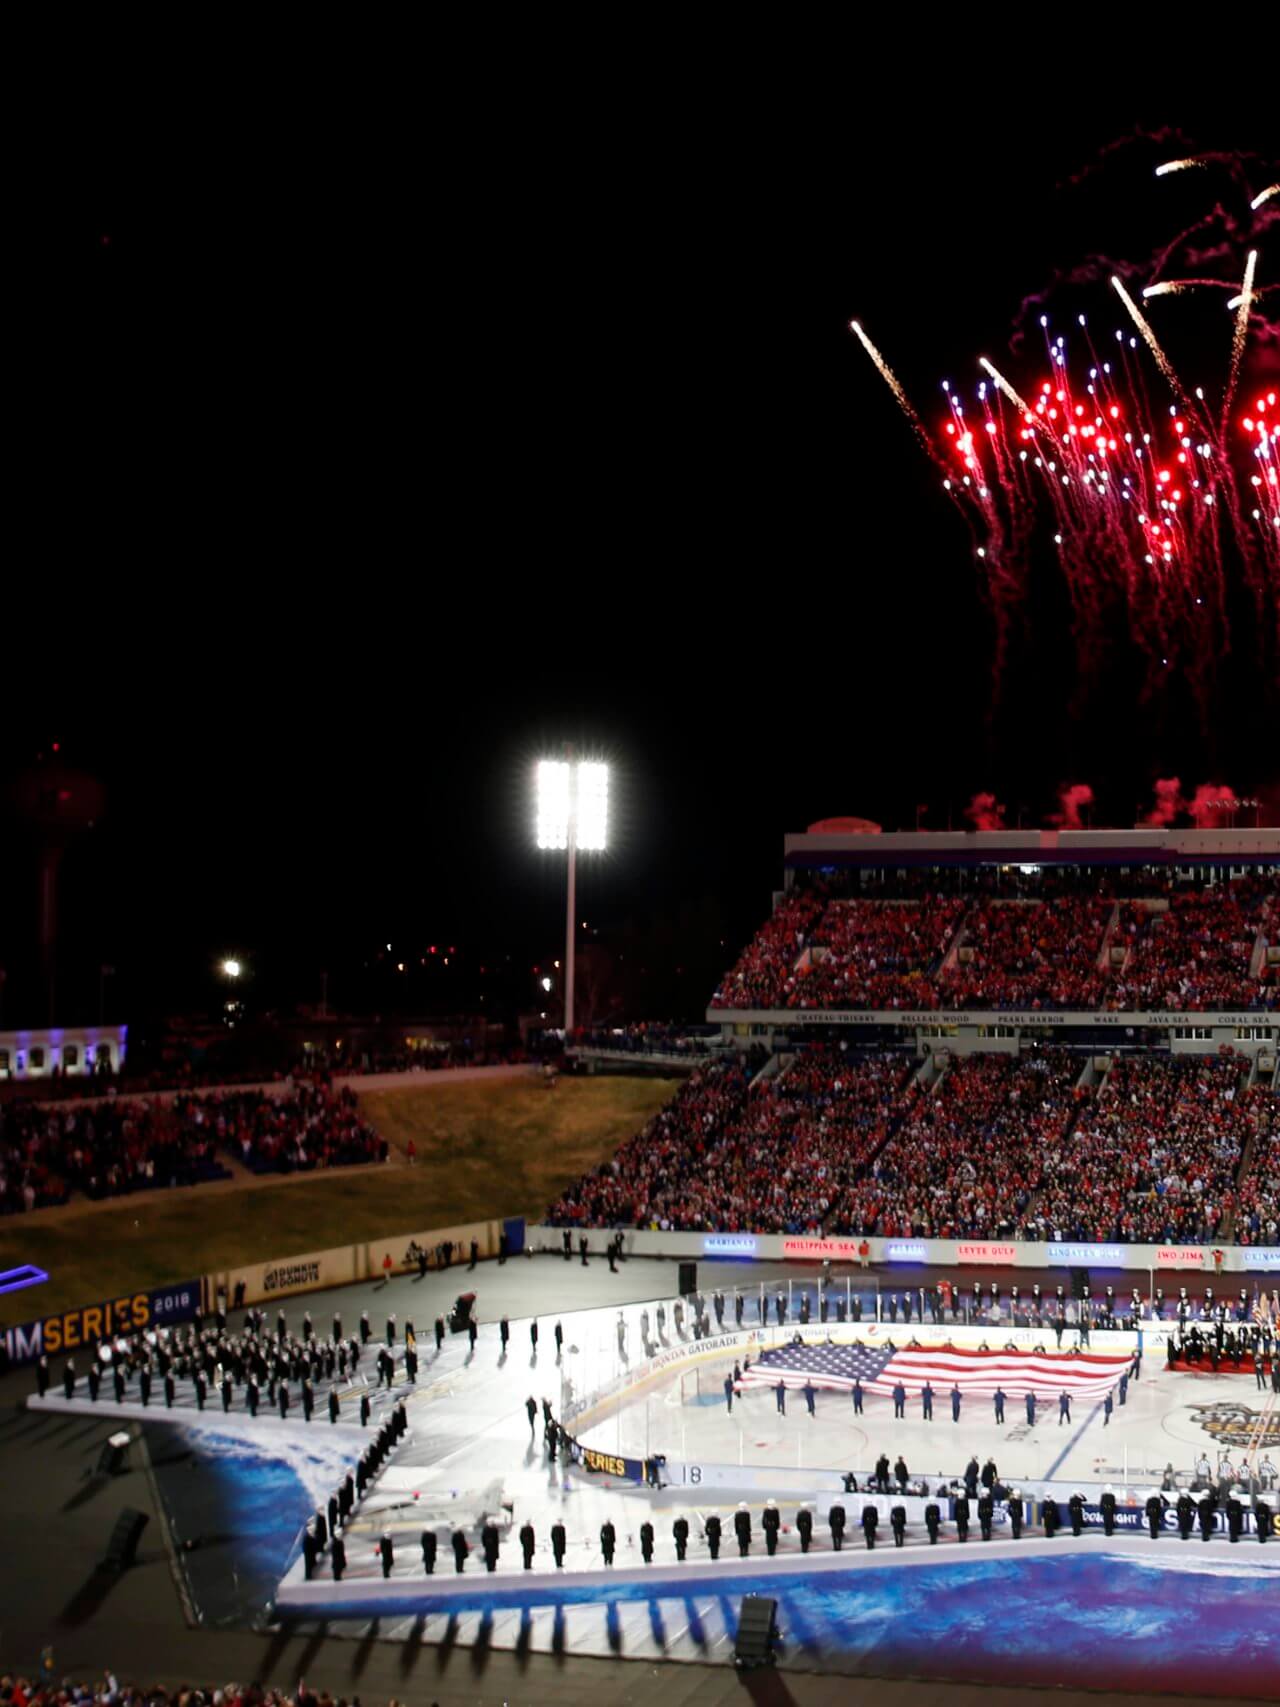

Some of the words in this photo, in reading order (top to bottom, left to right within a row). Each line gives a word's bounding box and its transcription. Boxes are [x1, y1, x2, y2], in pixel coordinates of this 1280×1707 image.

[998, 1015, 1025, 1023] PEARL
[1029, 1015, 1065, 1023] HARBOR
[1094, 1015, 1119, 1023] WAKE
[1149, 1016, 1169, 1024] JAVA
[1173, 1016, 1189, 1024] SEA
[1218, 1016, 1248, 1024] CORAL
[1253, 1016, 1270, 1024] SEA
[785, 1241, 834, 1251] PHILIPPINE
[838, 1243, 855, 1251] SEA
[959, 1246, 987, 1256] LEYTE
[991, 1247, 1015, 1256] GULF
[1158, 1250, 1176, 1260] IWO
[1180, 1251, 1203, 1260] JIMA
[279, 1273, 320, 1289] DONUTS
[44, 1294, 150, 1352] SERIES
[154, 1292, 190, 1313] 2018
[688, 1335, 739, 1354] GATORADE
[682, 1465, 702, 1484] 18
